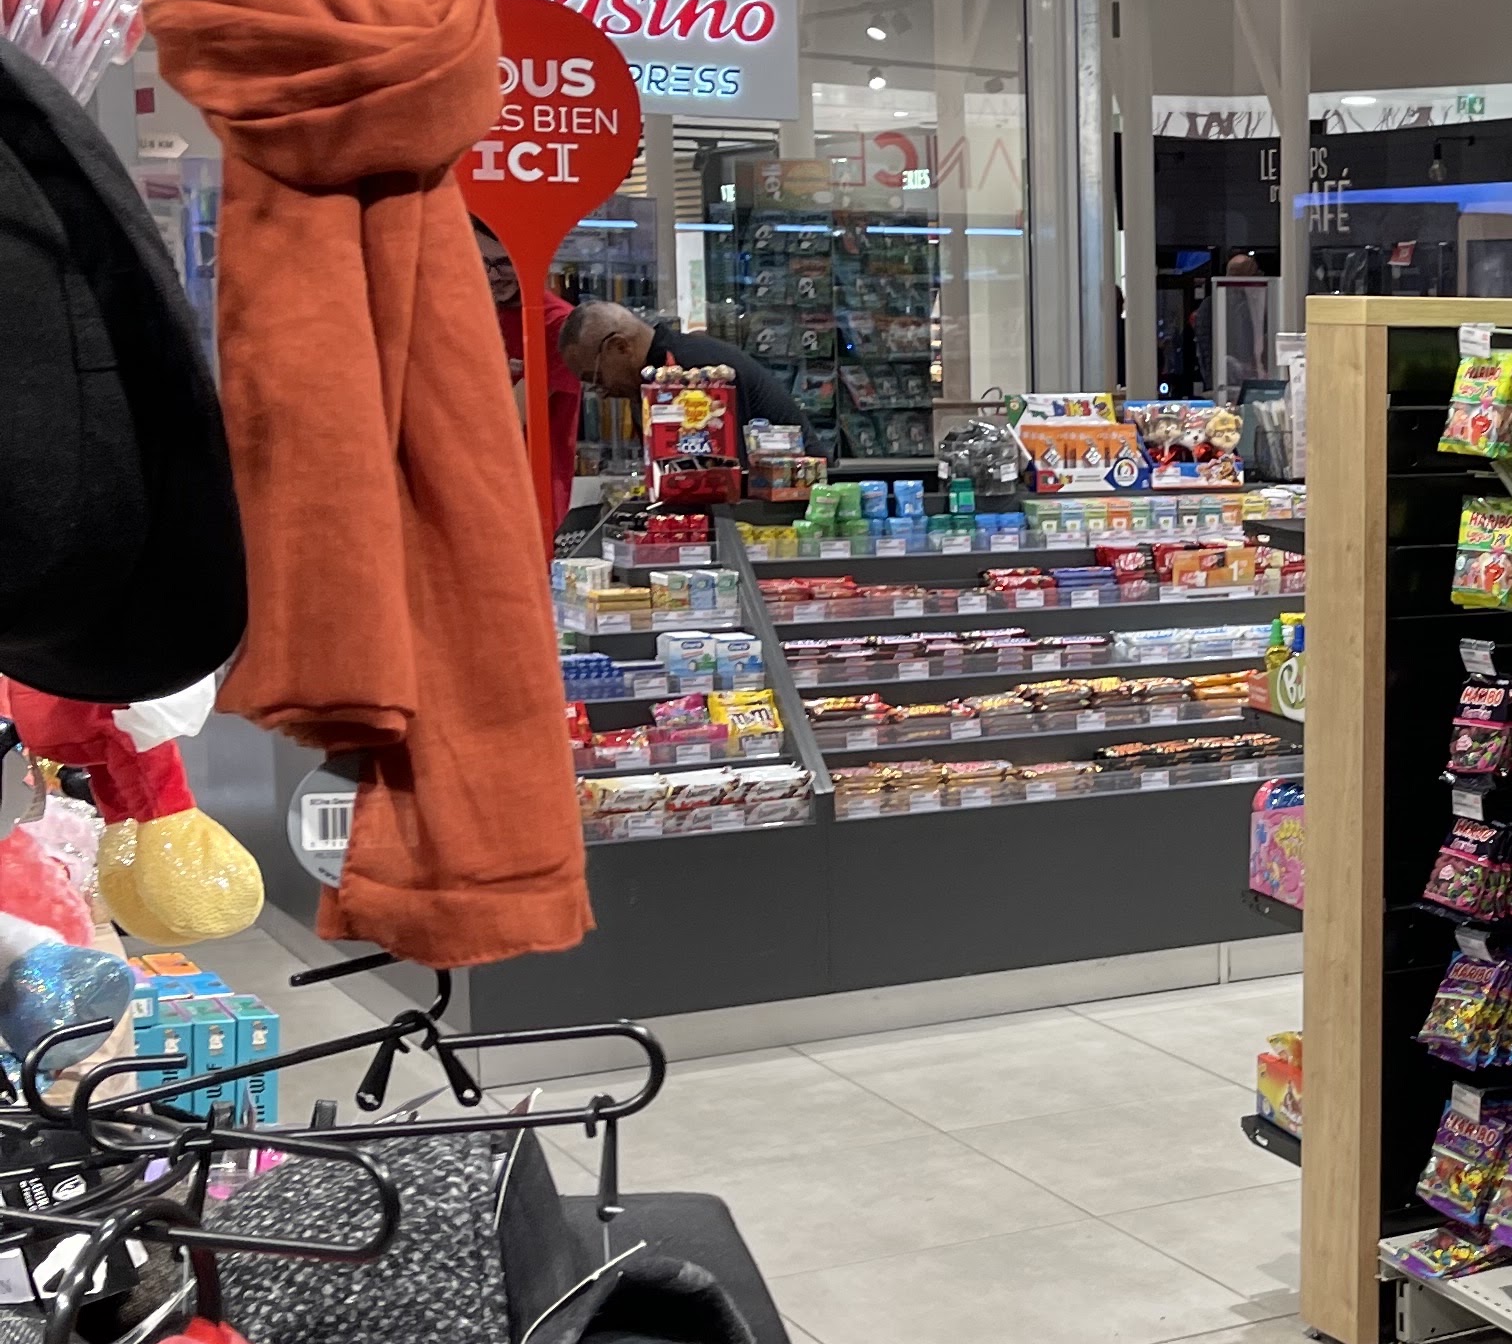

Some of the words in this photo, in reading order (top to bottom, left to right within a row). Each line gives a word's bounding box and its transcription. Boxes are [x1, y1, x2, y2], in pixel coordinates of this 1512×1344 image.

[497, 57, 596, 98] OUS
[628, 63, 741, 96] PRESS
[533, 106, 618, 135] BIEN
[471, 140, 580, 183] ICI
[1308, 167, 1352, 234] AFÉ
